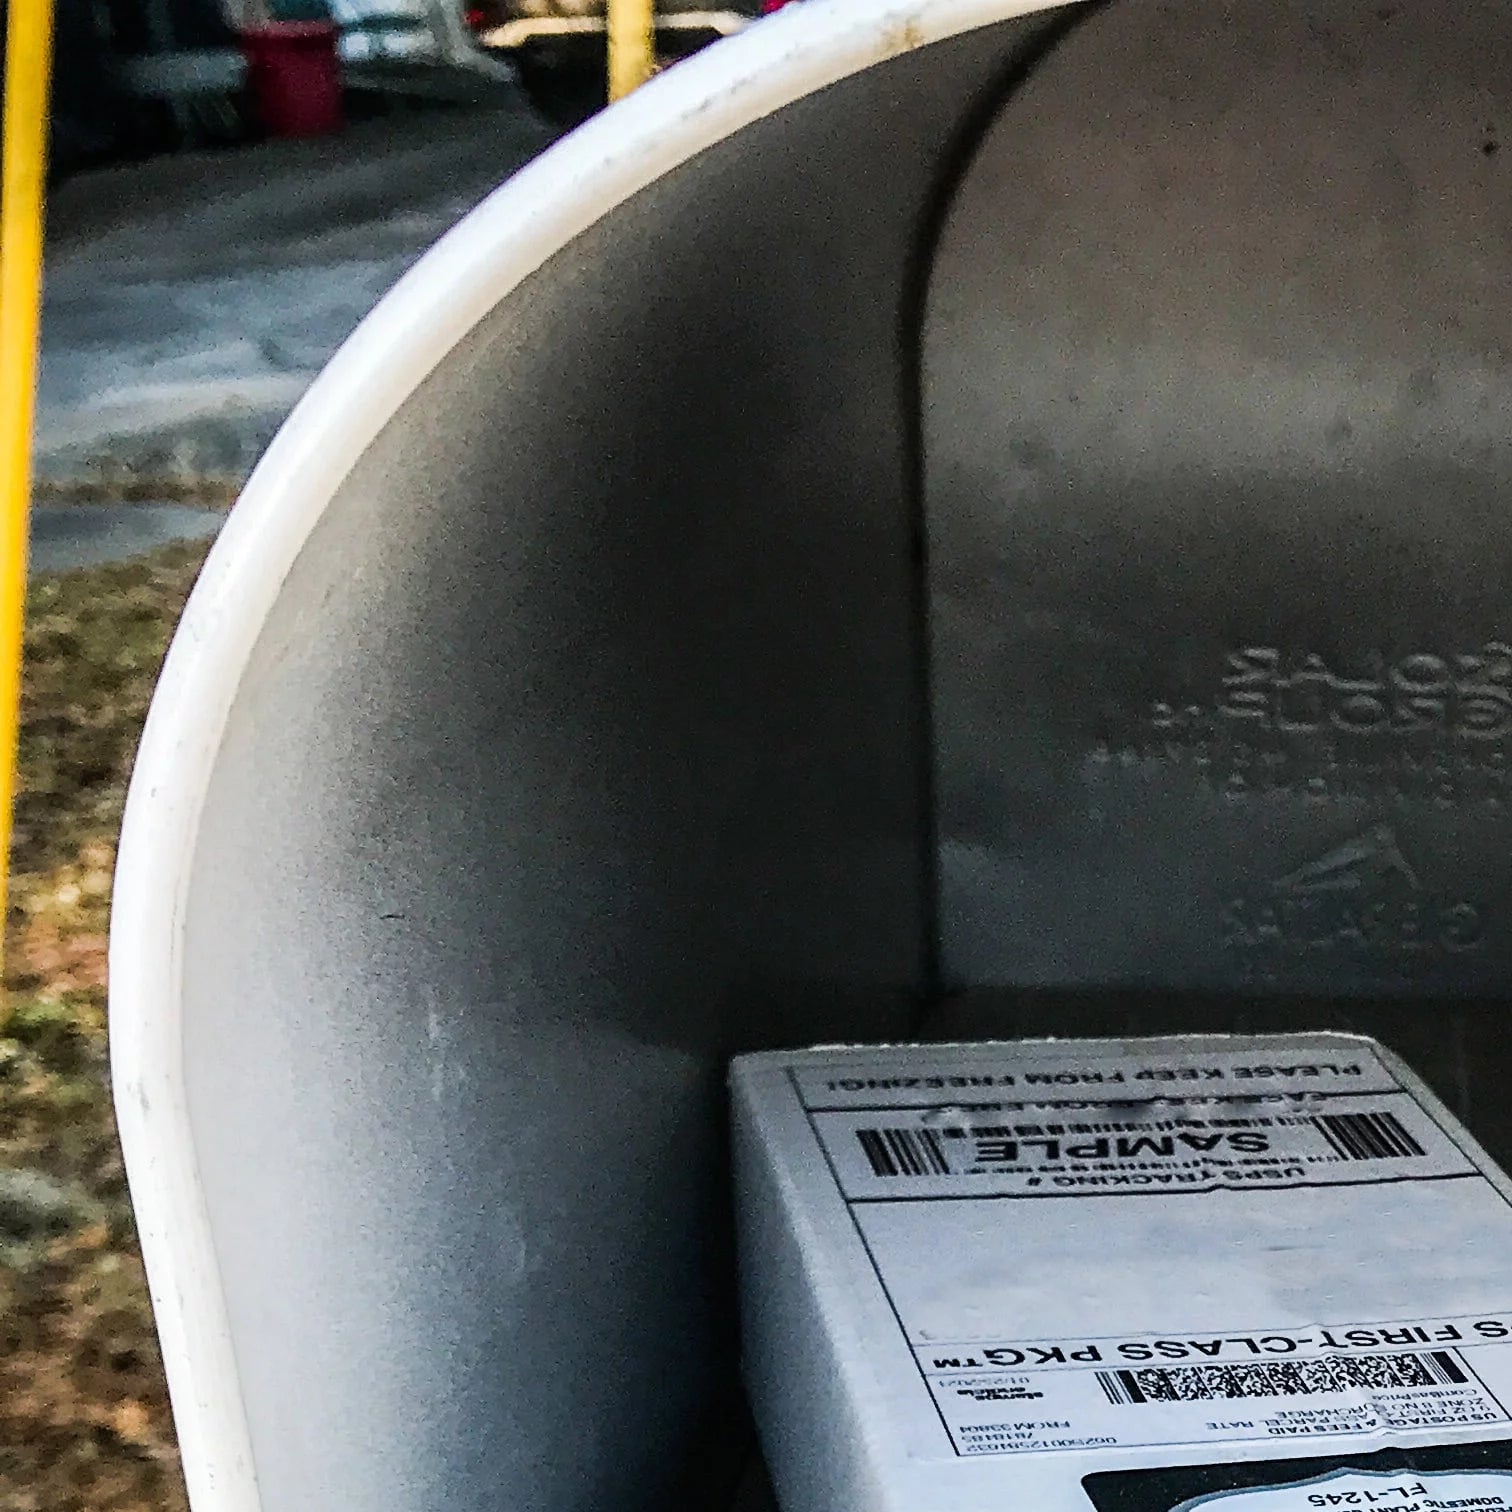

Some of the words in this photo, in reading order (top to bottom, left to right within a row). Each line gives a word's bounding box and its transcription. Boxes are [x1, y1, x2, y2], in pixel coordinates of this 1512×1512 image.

[1024, 1071, 1124, 1086] FROM
[1134, 1067, 1221, 1081] KEEP
[1230, 1064, 1361, 1080] PLEASE
[826, 1075, 1015, 1092] FREEZING!
[974, 1132, 1270, 1163] SAMPLE
[1052, 1170, 1215, 1188] TRACKING
[1221, 1166, 1305, 1180] USPS
[1116, 1324, 1463, 1361] FIRST-CLASS
[1259, 1416, 1331, 1428] PARCEL
[1385, 1413, 1469, 1427] POSTAGE
[1470, 1411, 1497, 1422] US
[1014, 1421, 1070, 1430] FROM
[1205, 1421, 1255, 1431] RATE
[1267, 1424, 1311, 1436] PAID
[1313, 1422, 1363, 1433] FEES
[1307, 1481, 1427, 1507] FL-1245
[1422, 1496, 1504, 1509] DOMESTIC
